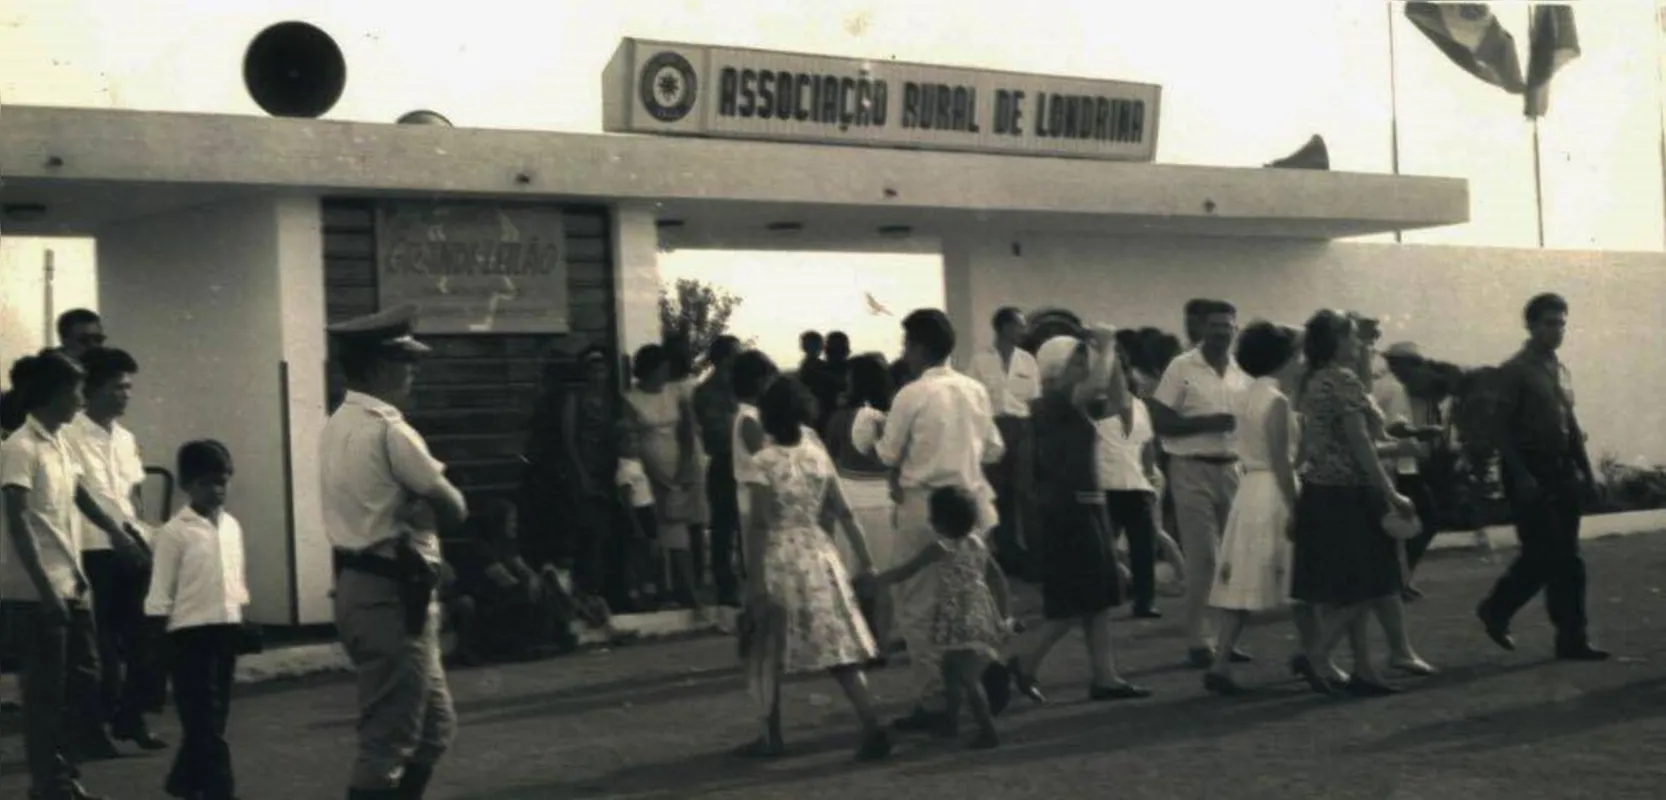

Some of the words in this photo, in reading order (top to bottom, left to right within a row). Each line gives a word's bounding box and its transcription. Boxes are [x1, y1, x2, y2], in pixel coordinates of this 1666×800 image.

[719, 66, 887, 132] ASSOCIAÇÃO
[902, 82, 979, 132] RURAL
[993, 88, 1024, 135] DE
[1035, 92, 1145, 143] LONDRINA
